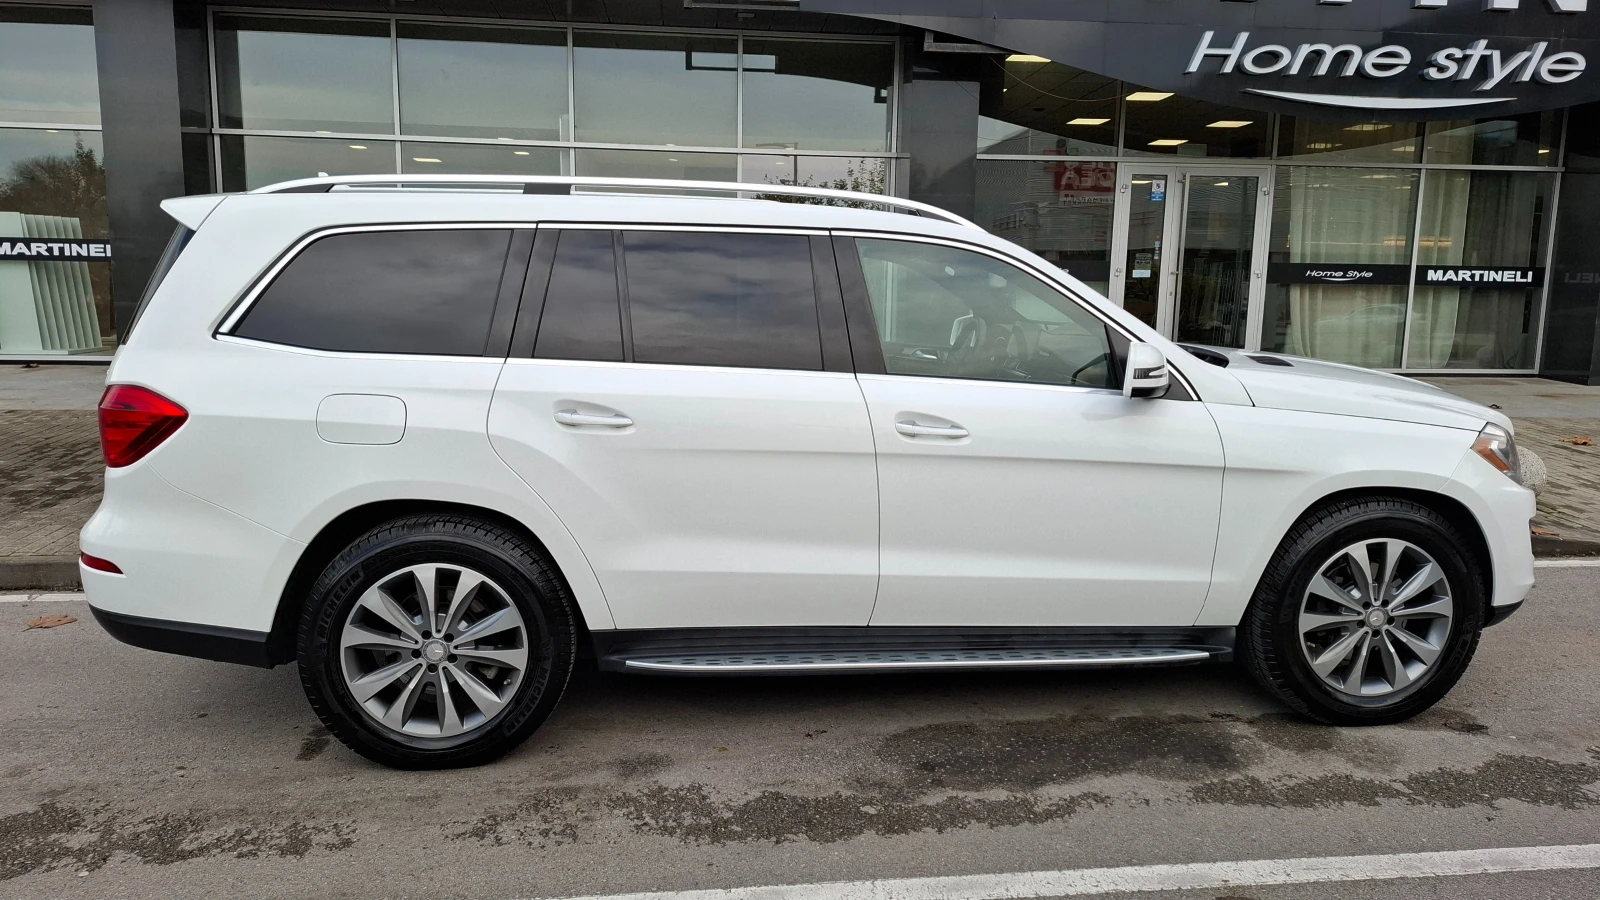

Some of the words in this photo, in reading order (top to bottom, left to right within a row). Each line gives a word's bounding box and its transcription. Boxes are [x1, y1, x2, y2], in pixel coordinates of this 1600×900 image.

[1184, 30, 1411, 78] Home
[1423, 39, 1586, 92] style
[1346, 270, 1373, 279] Style
[1427, 269, 1533, 283] MARTINELI
[316, 570, 361, 640] MICHELIN
[506, 667, 549, 733] MICHELIN
